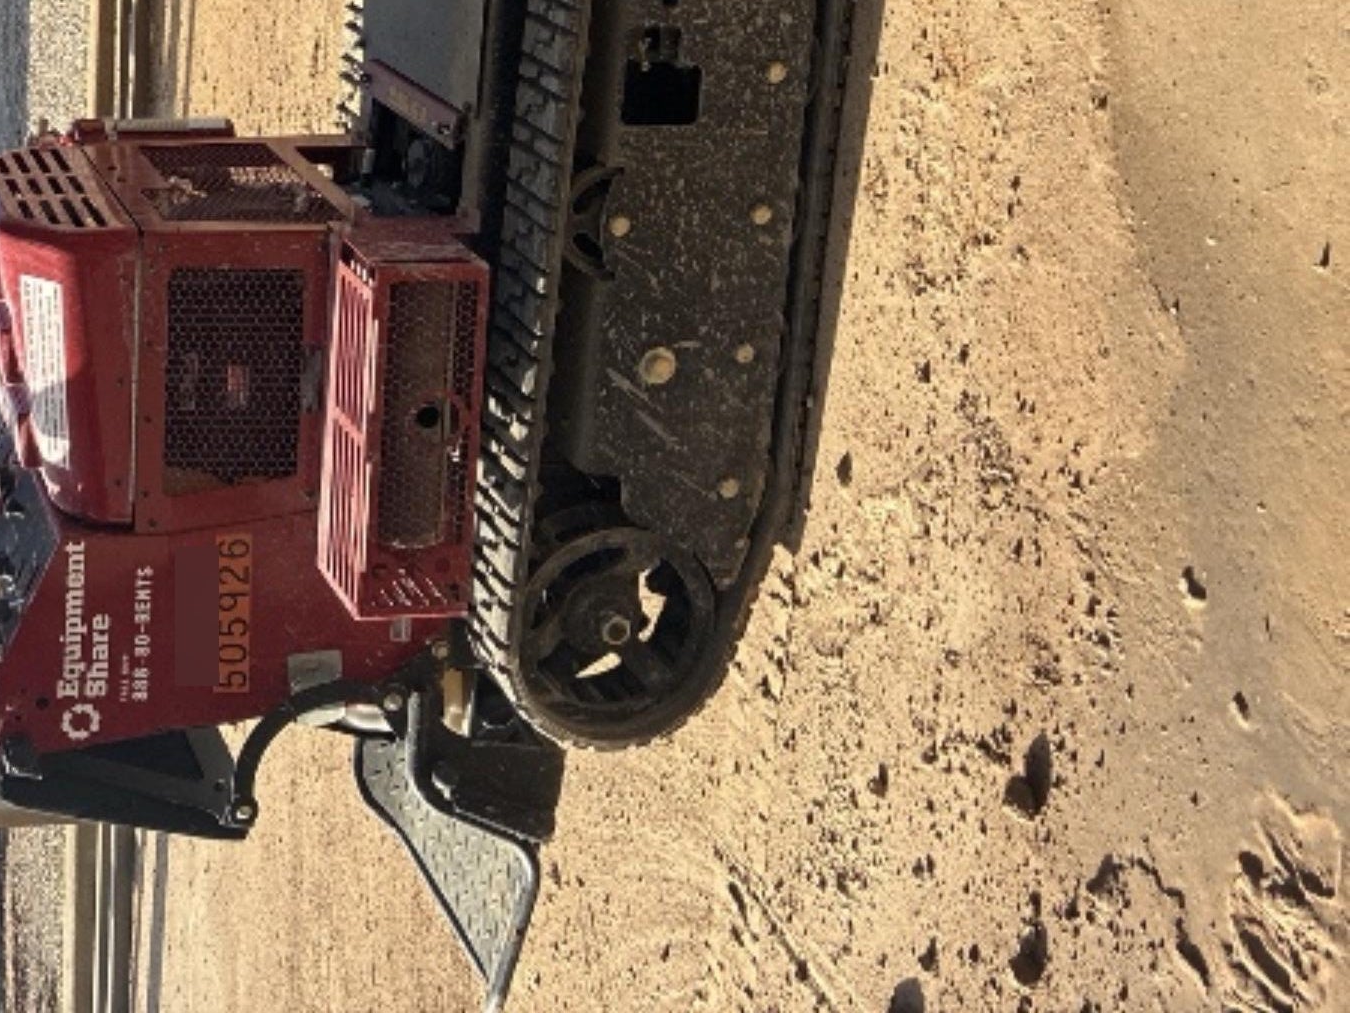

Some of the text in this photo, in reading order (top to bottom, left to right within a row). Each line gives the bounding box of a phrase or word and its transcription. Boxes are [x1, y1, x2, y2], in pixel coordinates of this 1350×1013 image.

[56, 540, 88, 700] Equipment
[84, 613, 110, 699] Share
[217, 538, 250, 690] 505926
